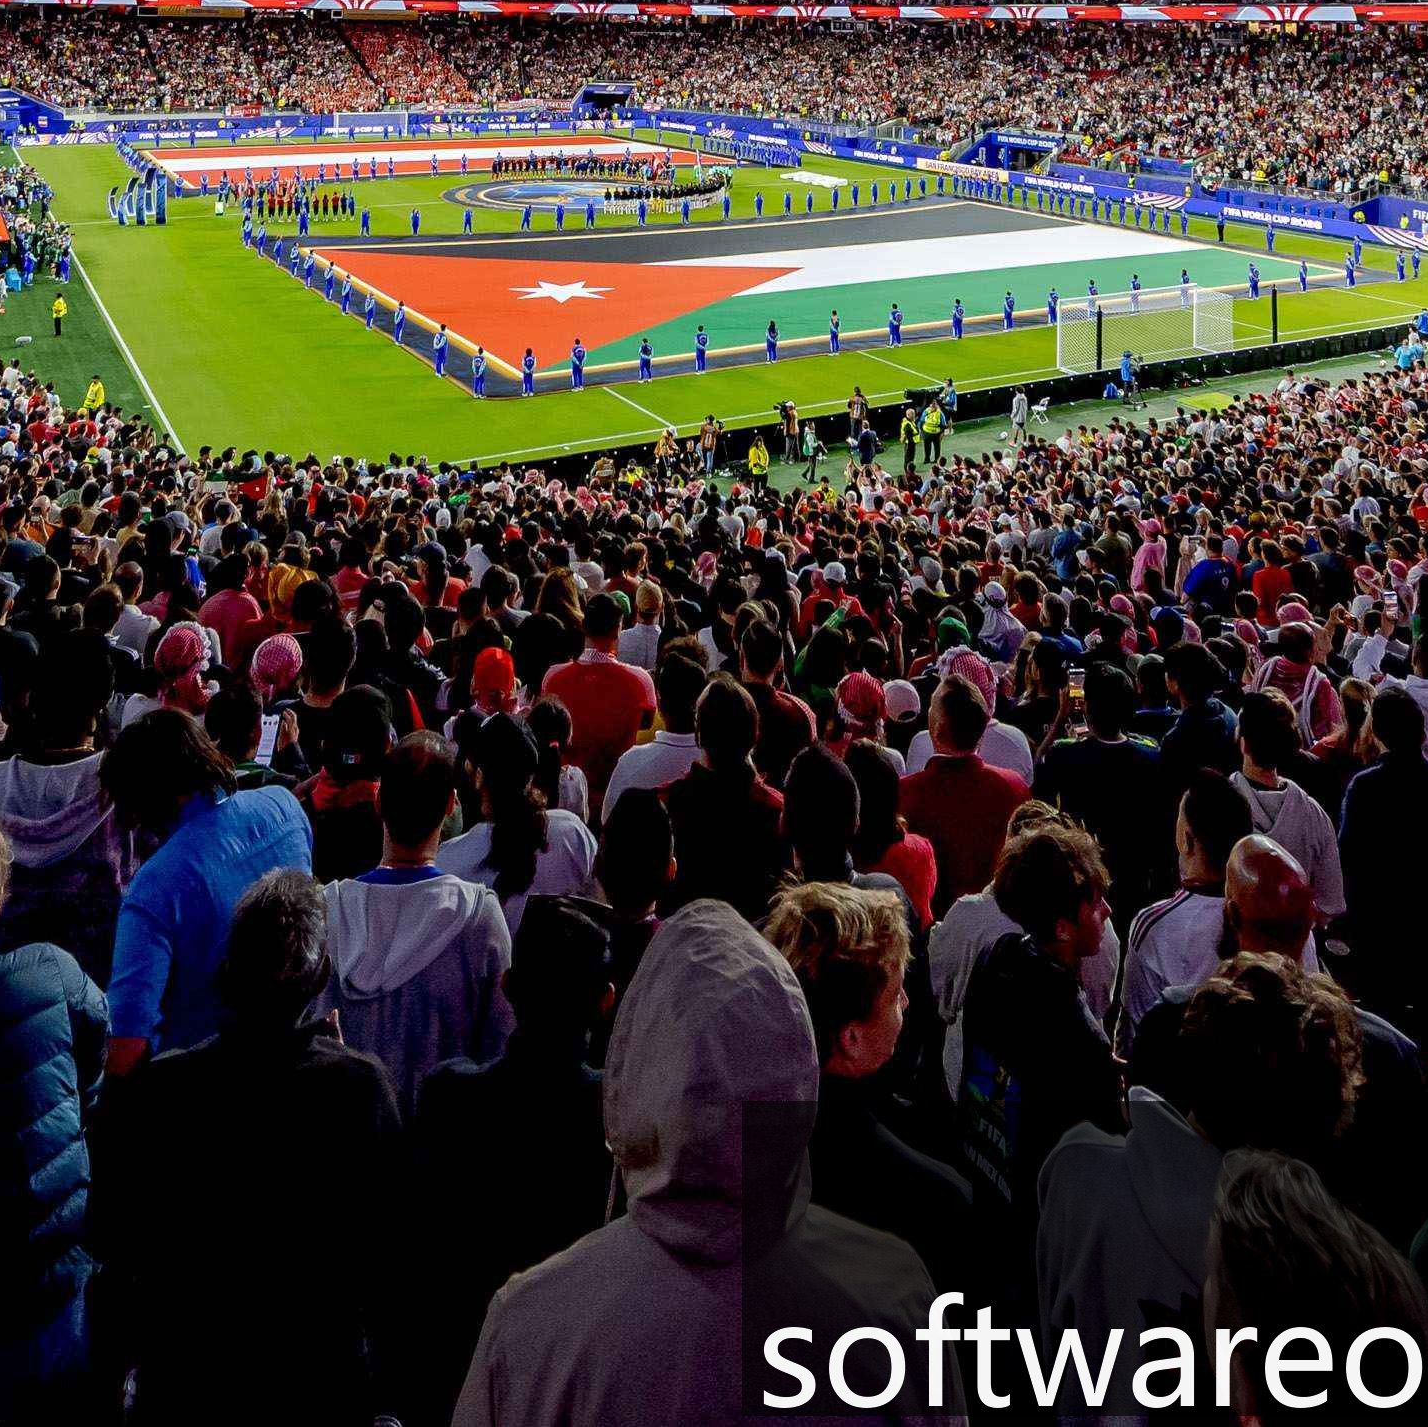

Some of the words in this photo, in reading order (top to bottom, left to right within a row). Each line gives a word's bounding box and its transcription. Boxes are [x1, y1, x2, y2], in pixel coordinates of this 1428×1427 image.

[1223, 207, 1242, 218] FIFA
[1242, 209, 1273, 221] WORLD
[1274, 214, 1290, 224] CUP
